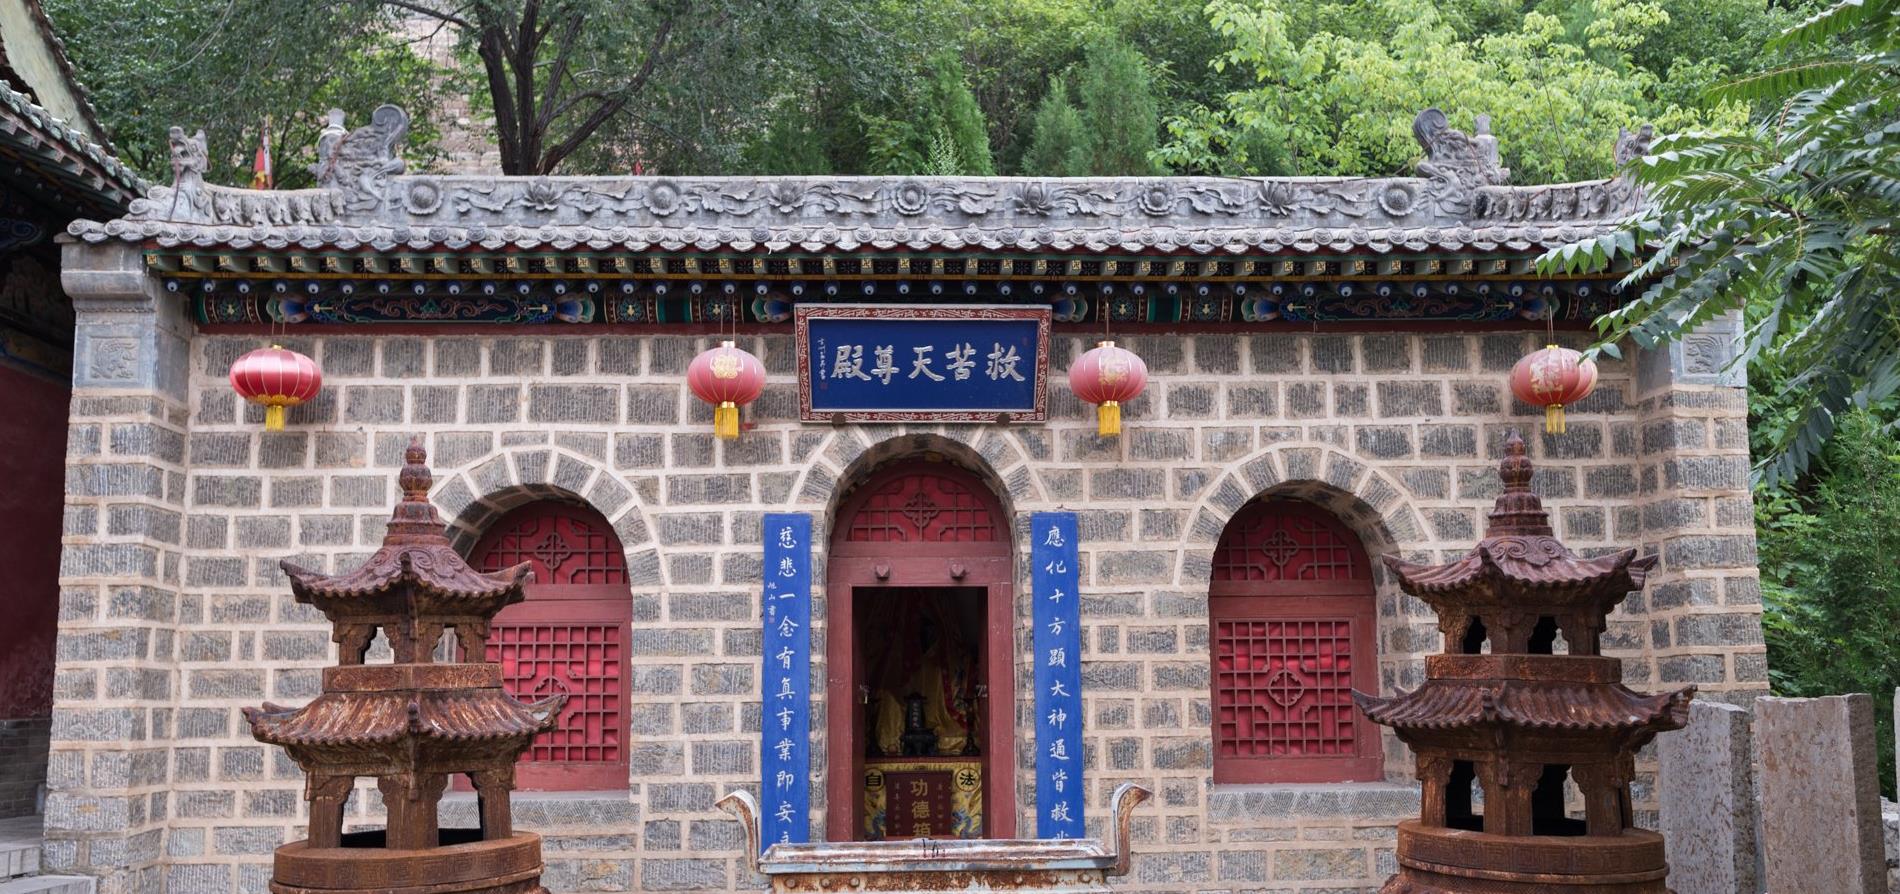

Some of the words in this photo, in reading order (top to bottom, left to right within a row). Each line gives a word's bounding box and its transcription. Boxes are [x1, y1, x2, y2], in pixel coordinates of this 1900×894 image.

[831, 343, 1026, 385] 救苦天尊殿
[959, 772, 976, 786] 法
[910, 778, 931, 838] 功德箱
